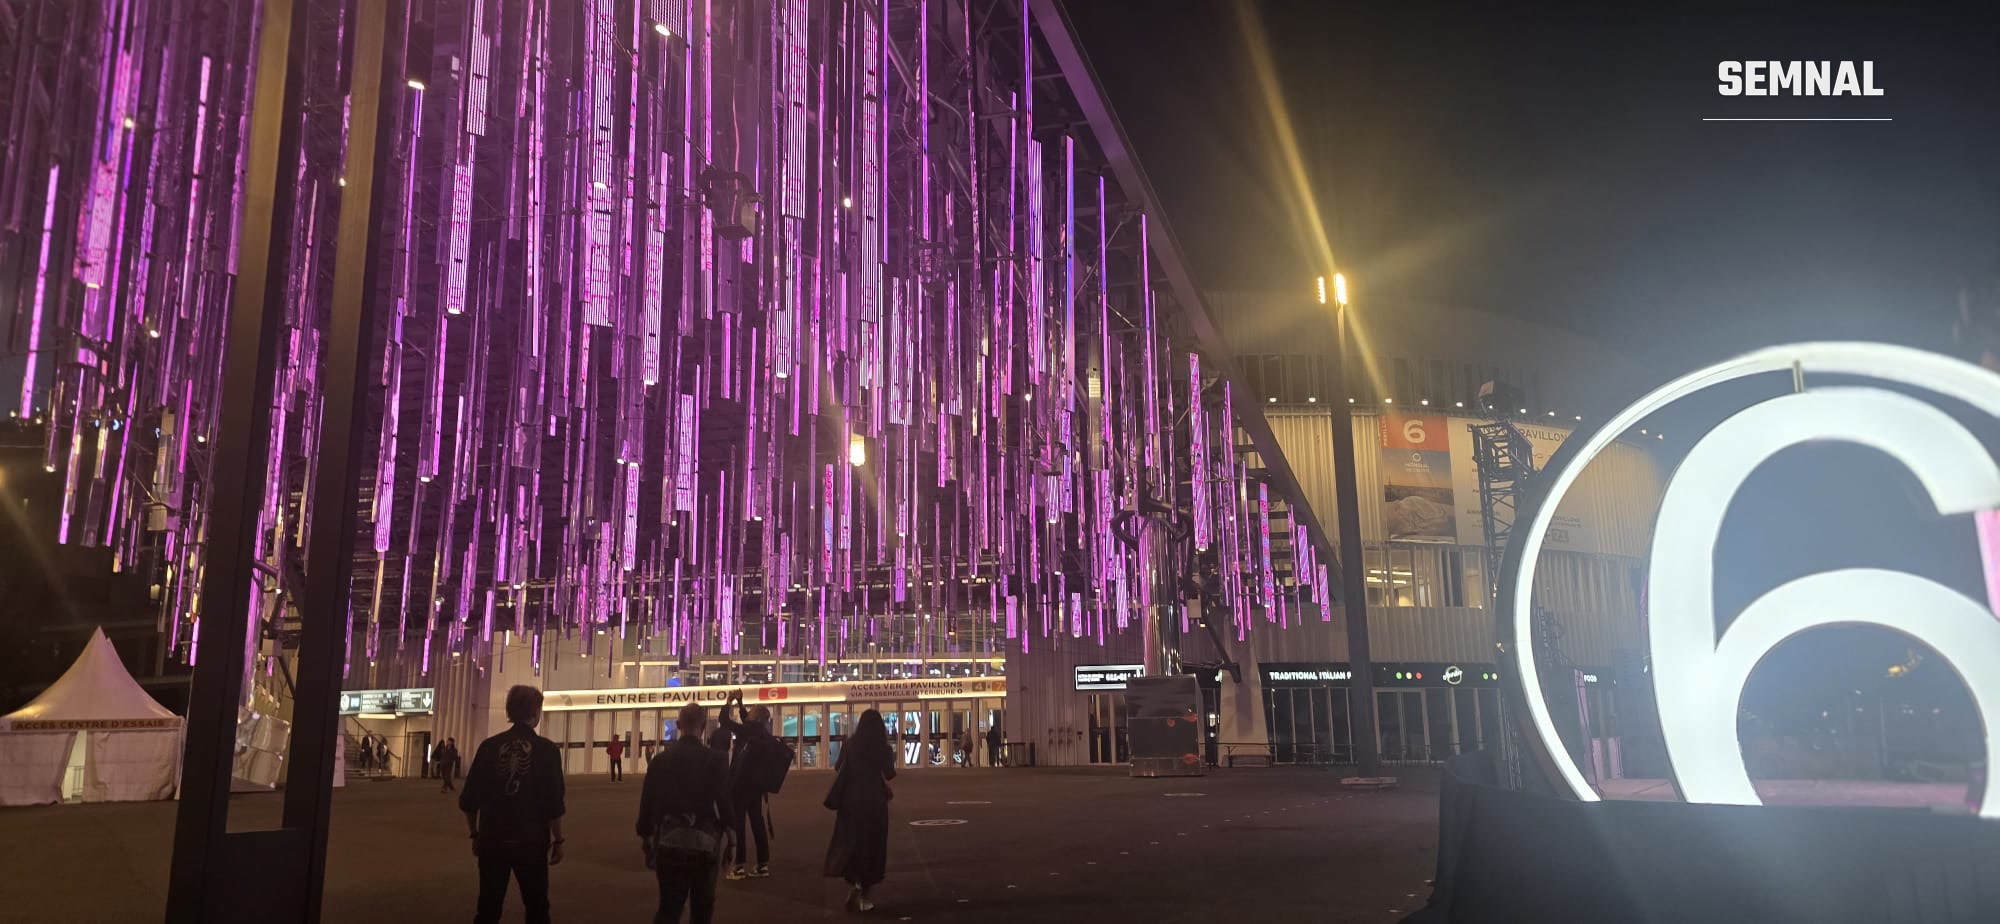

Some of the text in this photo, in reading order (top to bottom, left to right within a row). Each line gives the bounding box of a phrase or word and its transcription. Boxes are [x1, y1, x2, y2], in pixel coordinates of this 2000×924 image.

[1403, 419, 1426, 443] 6
[1648, 386, 2000, 817] 6
[1269, 671, 1318, 680] TRADITIONAL
[1319, 671, 1346, 680] ITALIAN
[910, 681, 963, 689] PAVILLONS
[662, 690, 727, 703] PAVILLO
[768, 688, 779, 698] 6
[60, 720, 107, 729] CENTRE
